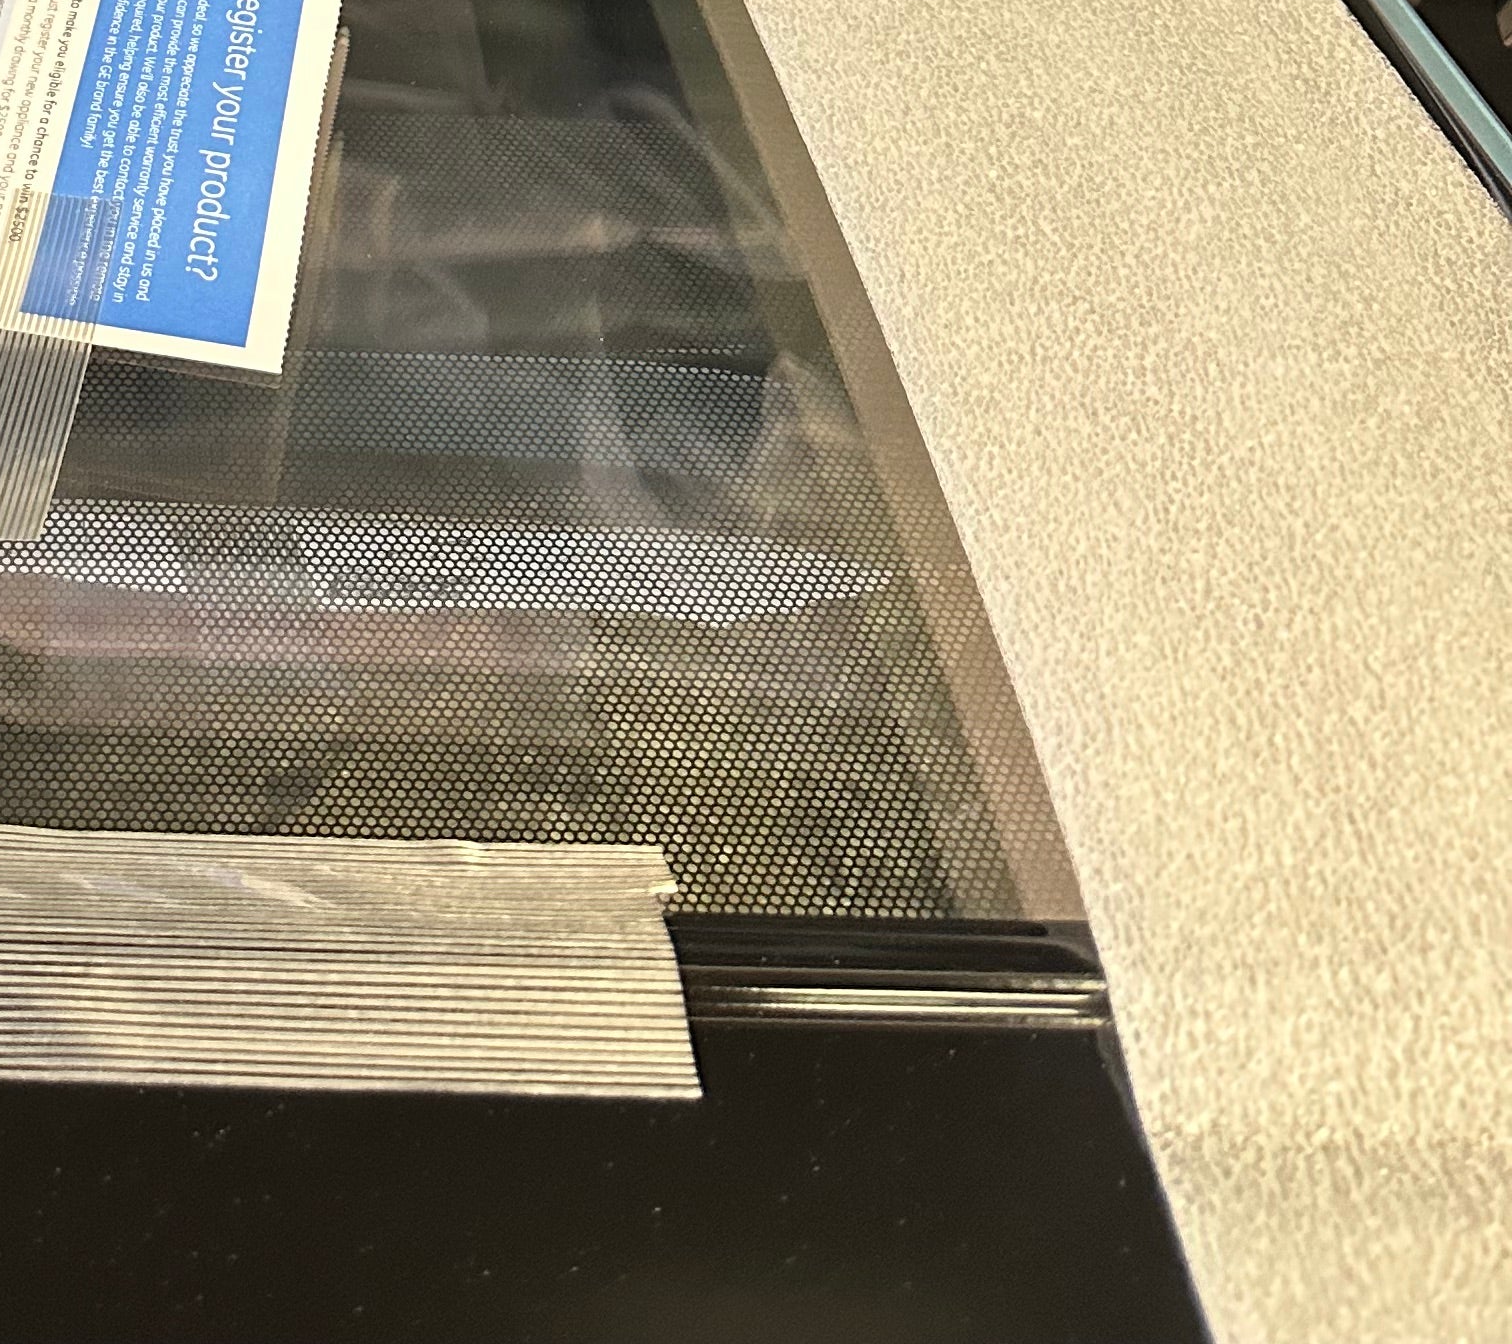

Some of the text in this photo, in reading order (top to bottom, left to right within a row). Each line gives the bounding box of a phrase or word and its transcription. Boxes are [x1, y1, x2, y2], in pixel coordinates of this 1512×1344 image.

[37, 13, 55, 50] register
[62, 10, 77, 37] make
[191, 23, 203, 36] so
[56, 38, 69, 58] you
[106, 35, 117, 44] in
[187, 37, 199, 52] we
[31, 50, 44, 74] your
[101, 46, 117, 63] the
[46, 60, 65, 97] eligible
[97, 64, 112, 79] GE
[176, 53, 196, 107] appreciate
[24, 75, 37, 98] new
[90, 80, 109, 111] brand
[42, 99, 57, 115] for
[171, 109, 187, 126] the
[210, 81, 243, 145] your
[8, 99, 31, 150] appliance
[79, 113, 102, 148] family!
[28, 126, 48, 166] chance
[166, 128, 182, 153] trust
[2, 152, 16, 173] and
[24, 168, 38, 180] to
[161, 153, 175, 175] you
[18, 183, 34, 203] win
[155, 177, 174, 206] have
[8, 205, 30, 244] $2500.
[185, 149, 230, 280] product?
[147, 207, 166, 248] placed
[144, 249, 158, 260] in
[140, 262, 153, 276] us
[135, 278, 150, 301] and
